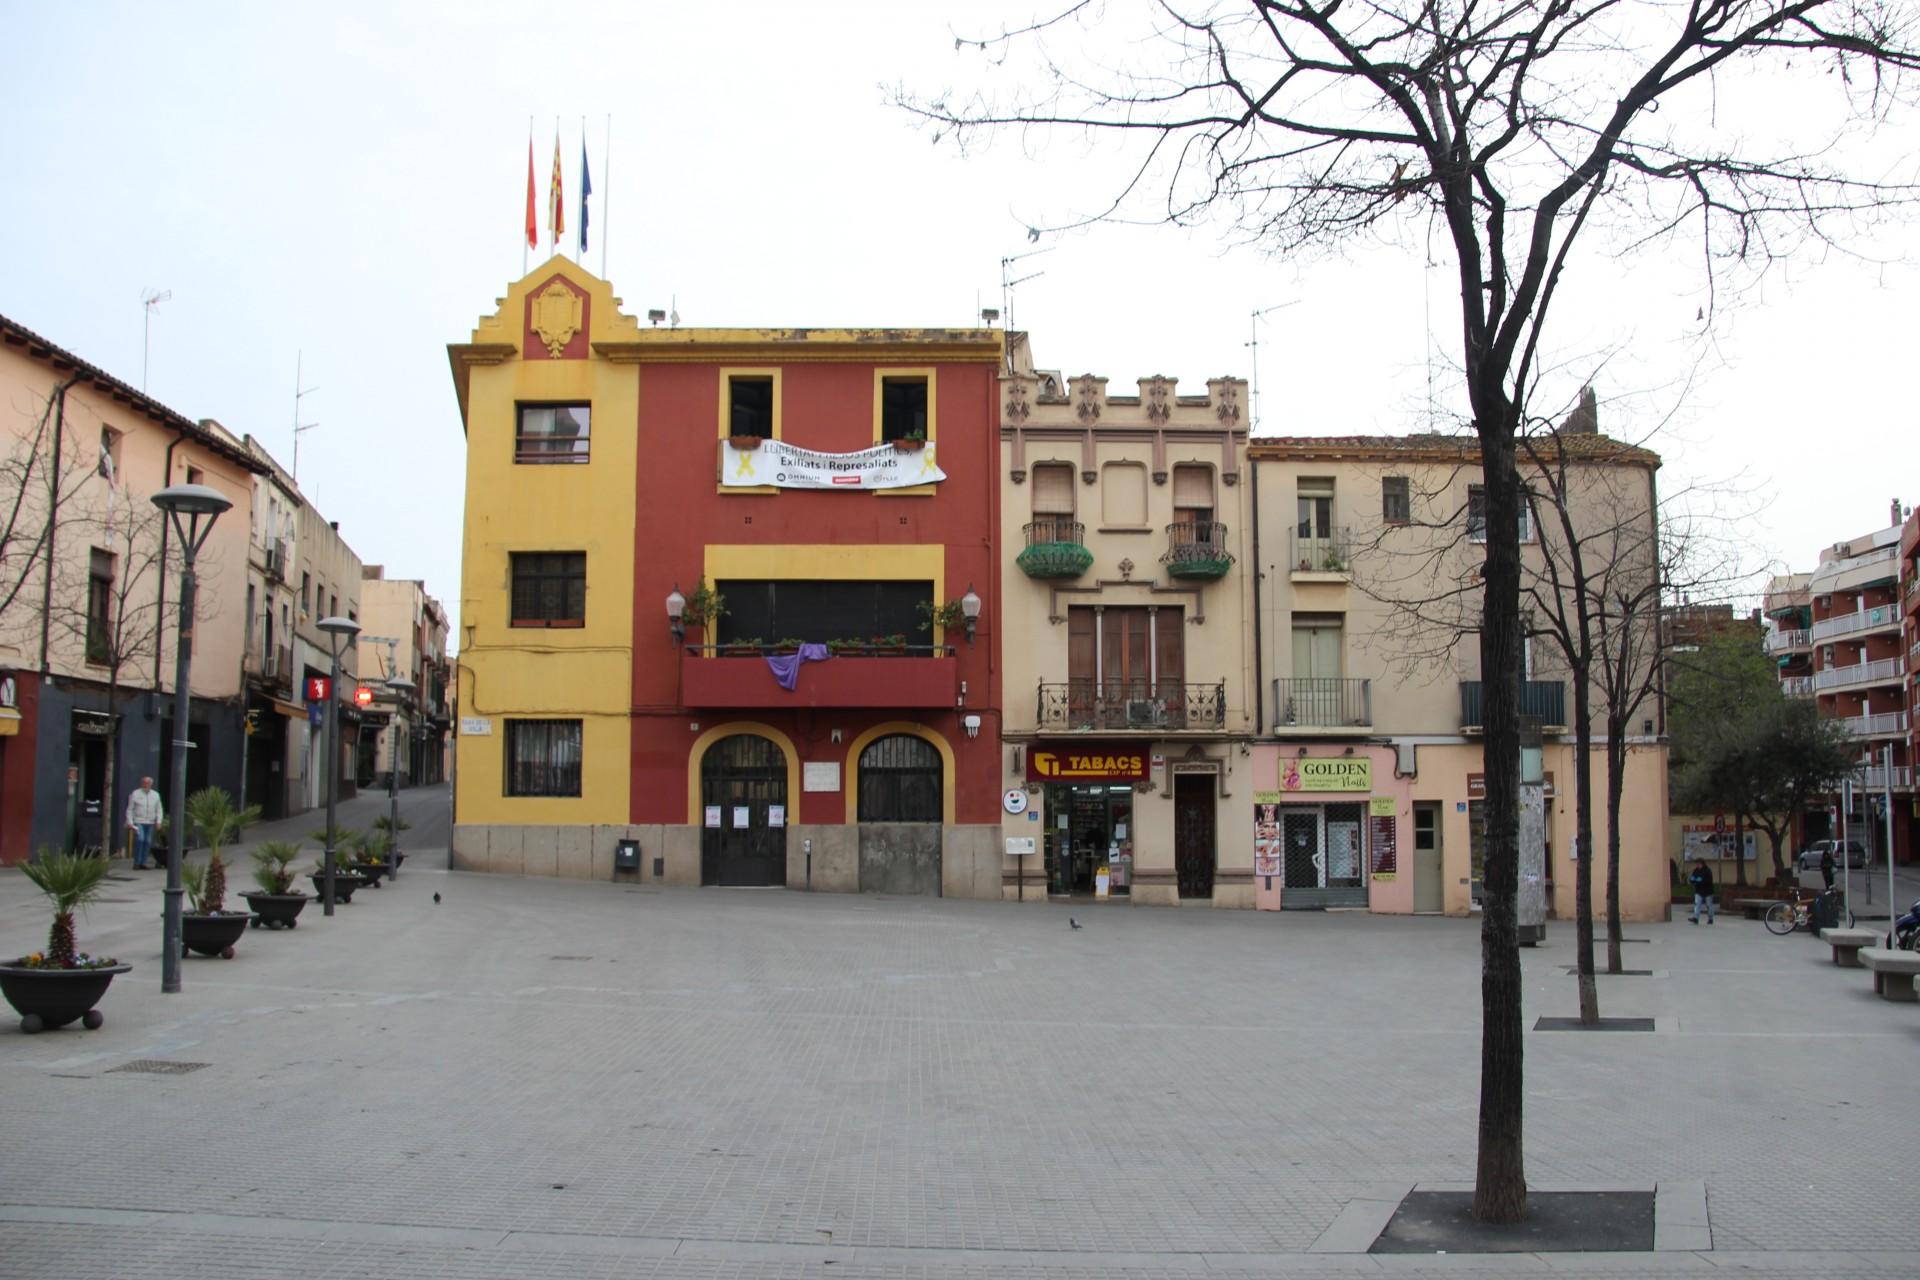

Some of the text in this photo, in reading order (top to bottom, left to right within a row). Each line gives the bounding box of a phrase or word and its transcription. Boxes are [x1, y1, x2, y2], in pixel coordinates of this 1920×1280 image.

[780, 456, 820, 469] Exiliats
[829, 457, 898, 472] Represaliats
[1068, 756, 1142, 770] TABACS
[1304, 763, 1367, 775] GOLDEN
[1341, 776, 1367, 787] Nails
